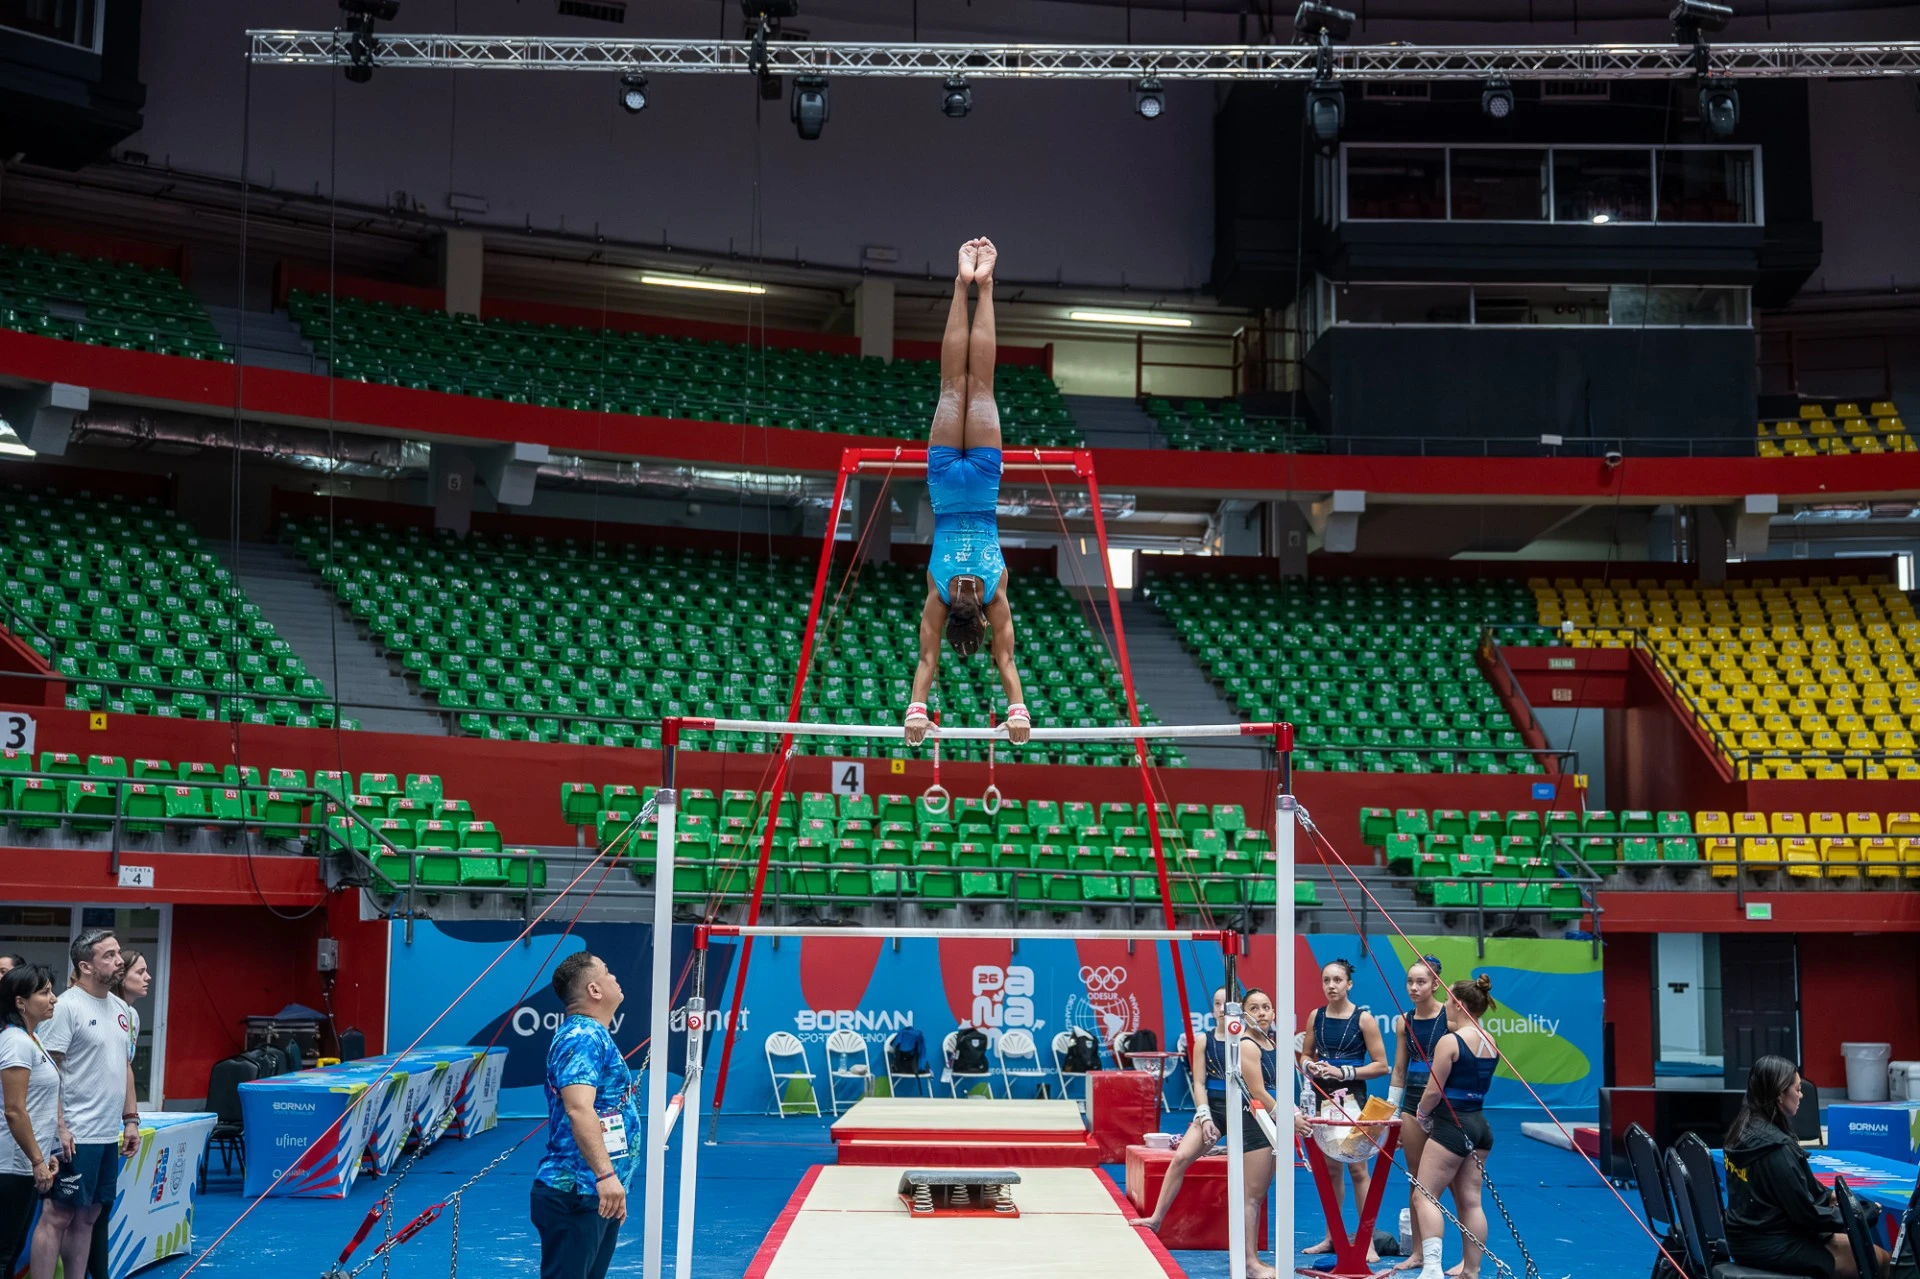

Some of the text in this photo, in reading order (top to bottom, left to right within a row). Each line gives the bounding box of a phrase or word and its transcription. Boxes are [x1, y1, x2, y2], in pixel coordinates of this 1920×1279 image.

[95, 717, 103, 726] 4
[6, 716, 26, 749] 3
[895, 763, 901, 771] 5
[841, 766, 859, 792] 4
[133, 873, 142, 885] 4
[978, 974, 999, 984] 26
[1087, 992, 1119, 1000] ODESUR
[794, 1010, 914, 1031] BORNAN
[1487, 1014, 1560, 1037] quality
[272, 1102, 316, 1111] BORNAN
[1849, 1122, 1889, 1132] BORNAN
[276, 1133, 308, 1148] ufinet
